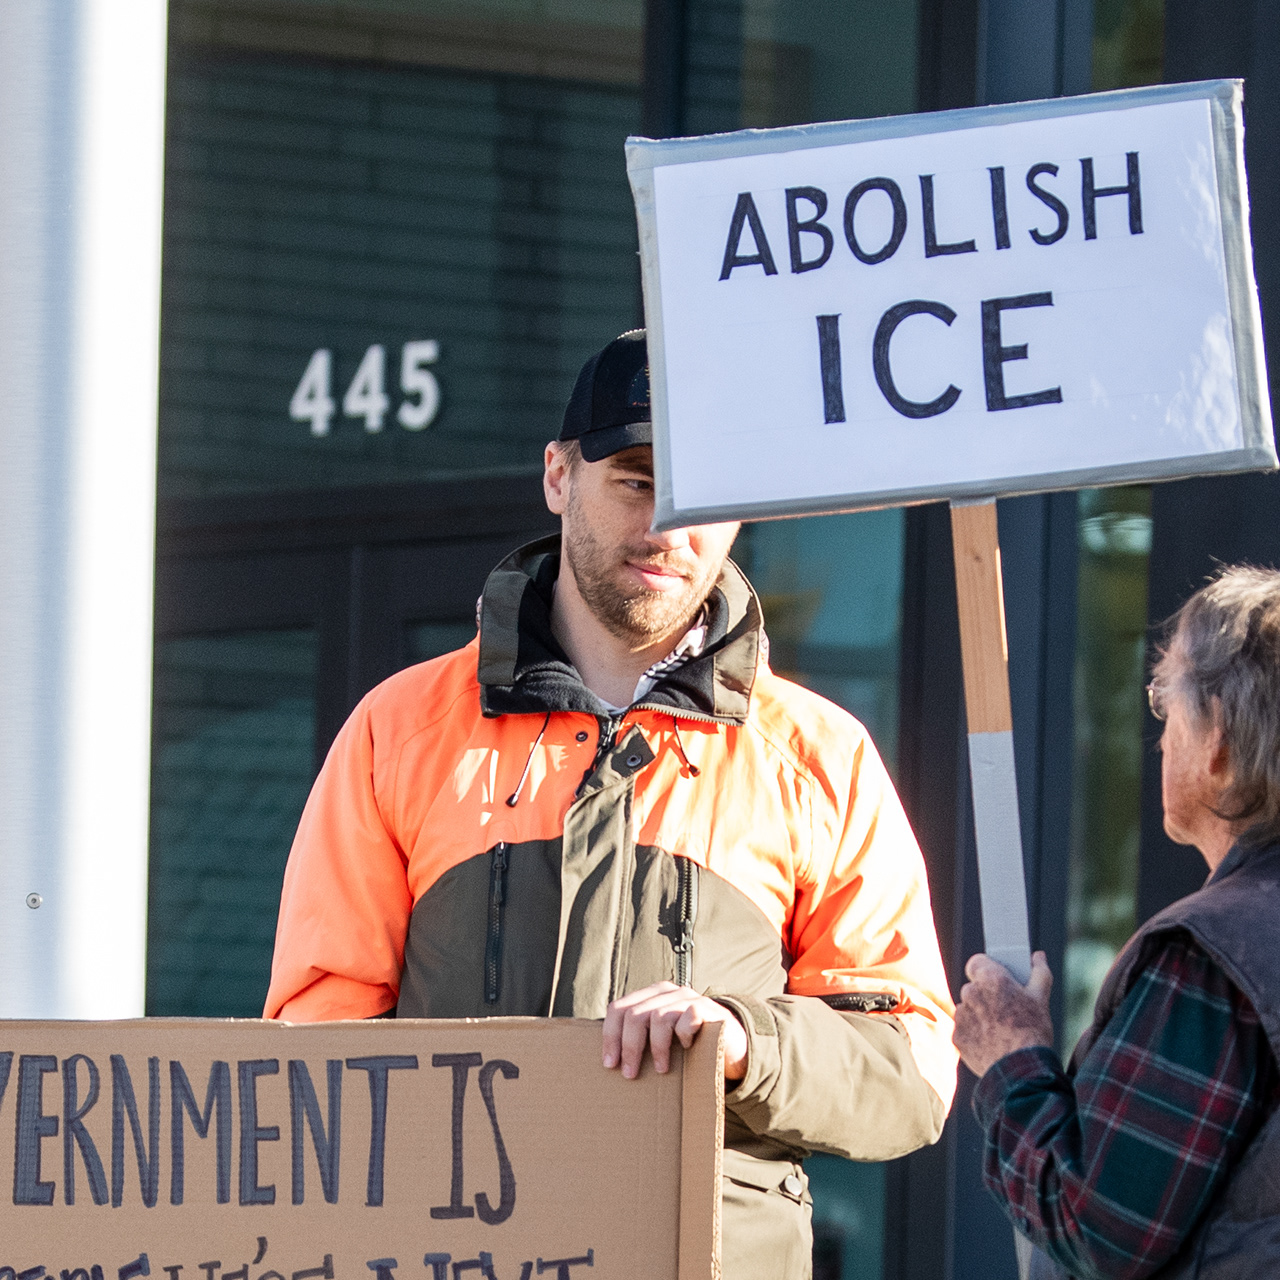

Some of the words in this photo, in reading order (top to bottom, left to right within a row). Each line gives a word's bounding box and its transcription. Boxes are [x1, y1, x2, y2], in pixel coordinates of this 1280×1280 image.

[718, 151, 1145, 282] ABOLISH
[289, 339, 440, 437] 445
[815, 291, 1064, 425] ICE
[429, 1052, 520, 1226] IS
